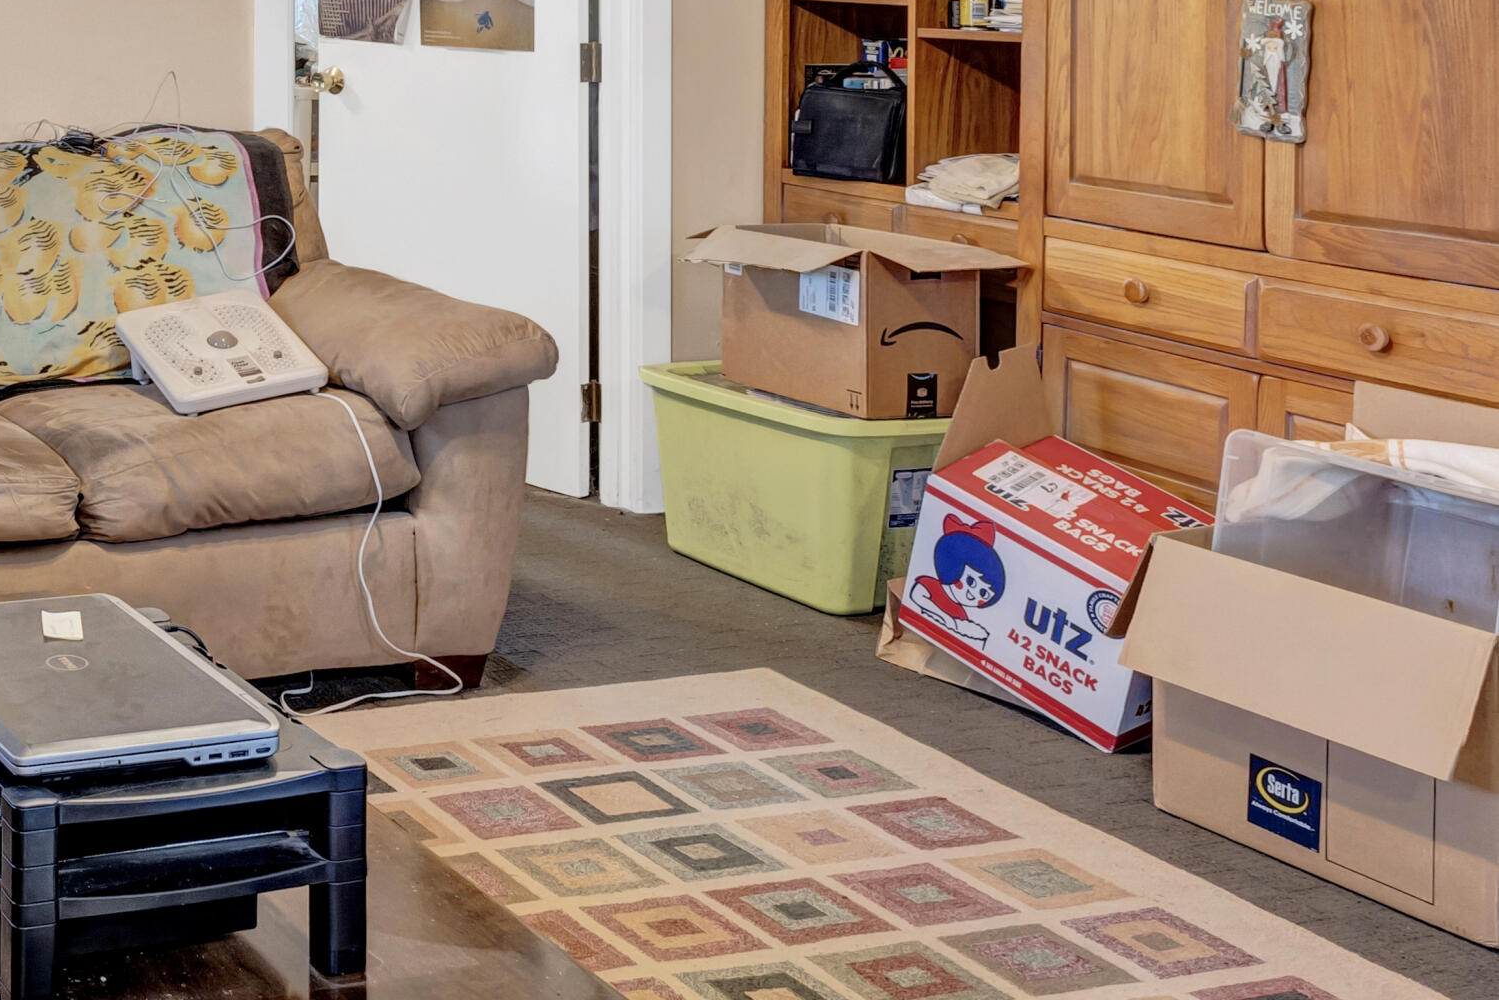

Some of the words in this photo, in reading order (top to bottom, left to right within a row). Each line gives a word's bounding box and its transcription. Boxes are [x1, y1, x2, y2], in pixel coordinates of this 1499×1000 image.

[1055, 463, 1122, 500] SNACK
[1086, 468, 1142, 498] BAGS
[1120, 498, 1150, 514] 42
[1053, 519, 1115, 553] BAGS
[1075, 515, 1143, 558] SNACK
[1024, 597, 1092, 661] utz
[1007, 628, 1032, 652] 42
[1035, 645, 1099, 692] SNACK
[1023, 656, 1074, 696] BAGS
[1267, 773, 1300, 805] Serta
